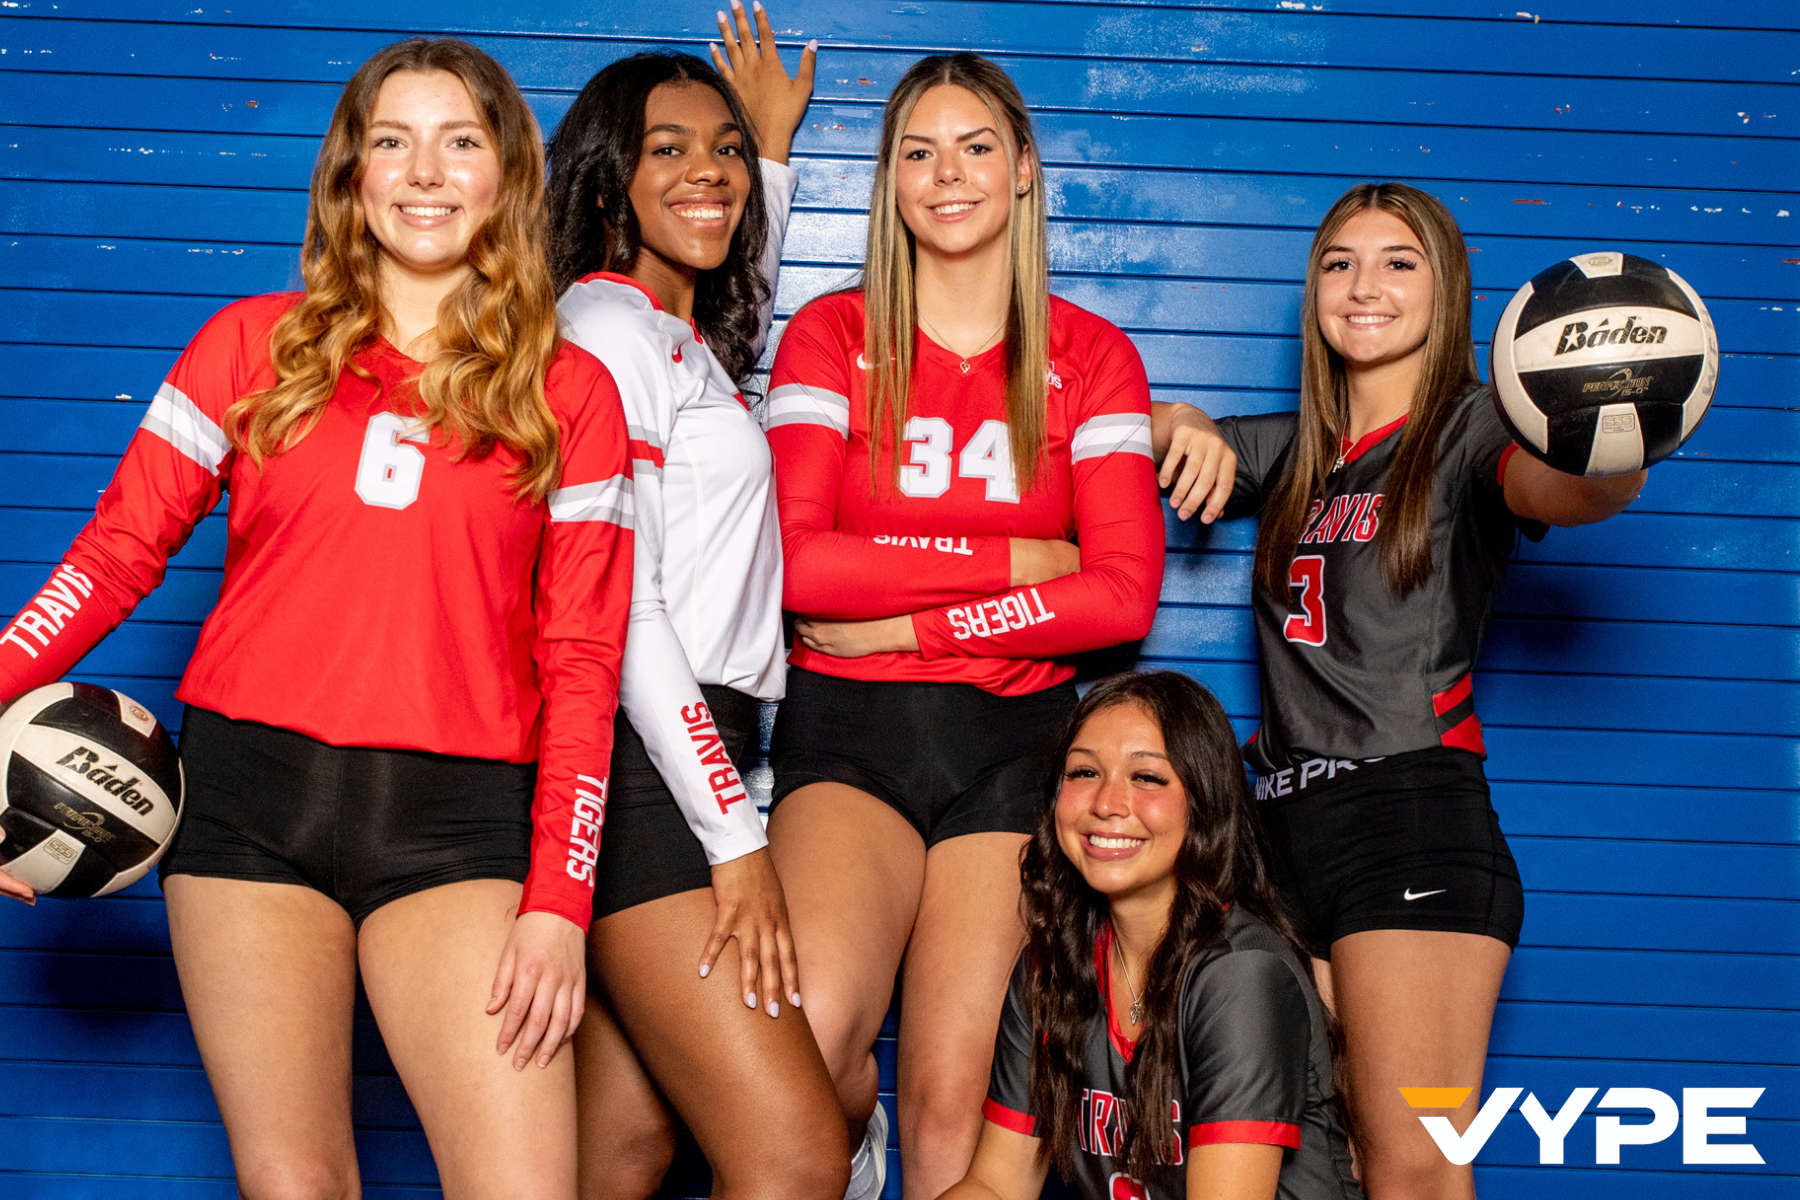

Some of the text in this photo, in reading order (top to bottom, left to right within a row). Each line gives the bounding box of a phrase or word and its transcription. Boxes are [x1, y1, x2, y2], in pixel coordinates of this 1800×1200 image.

[354, 410, 432, 511] 6
[898, 416, 1021, 504] 34
[1298, 493, 1385, 544] RAVIS
[0, 564, 93, 659] TRAVIS
[947, 588, 1055, 640] TIGERS
[1283, 555, 1327, 647] 3
[680, 701, 746, 815] TRAVIS
[1299, 757, 1386, 790] PR
[566, 774, 607, 887] TIGERS
[1078, 1088, 1183, 1165] TRAS
